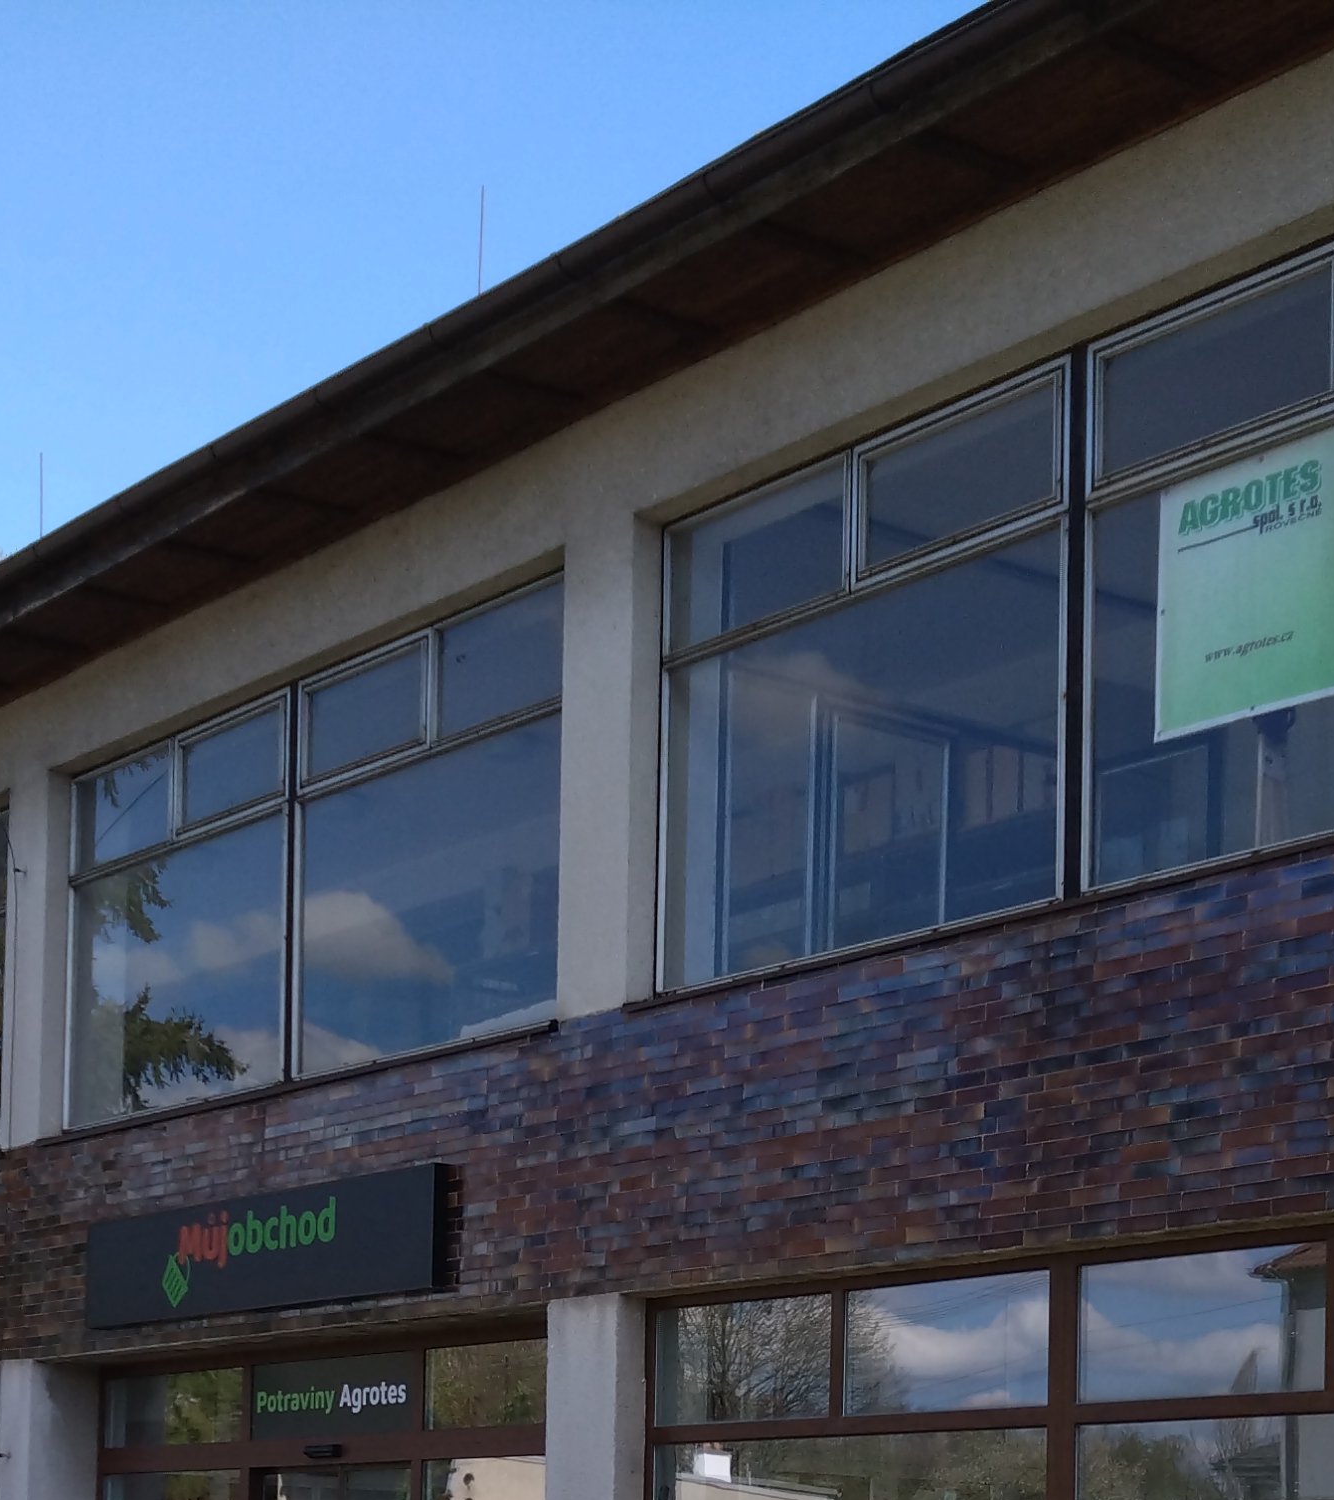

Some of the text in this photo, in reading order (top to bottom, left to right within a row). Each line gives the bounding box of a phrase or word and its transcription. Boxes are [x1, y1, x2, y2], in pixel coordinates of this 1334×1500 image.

[1178, 459, 1322, 536] AGROTES
[1204, 630, 1295, 664] www.agrotes.cz
[256, 1381, 408, 1415] Potraviny Agrotes
